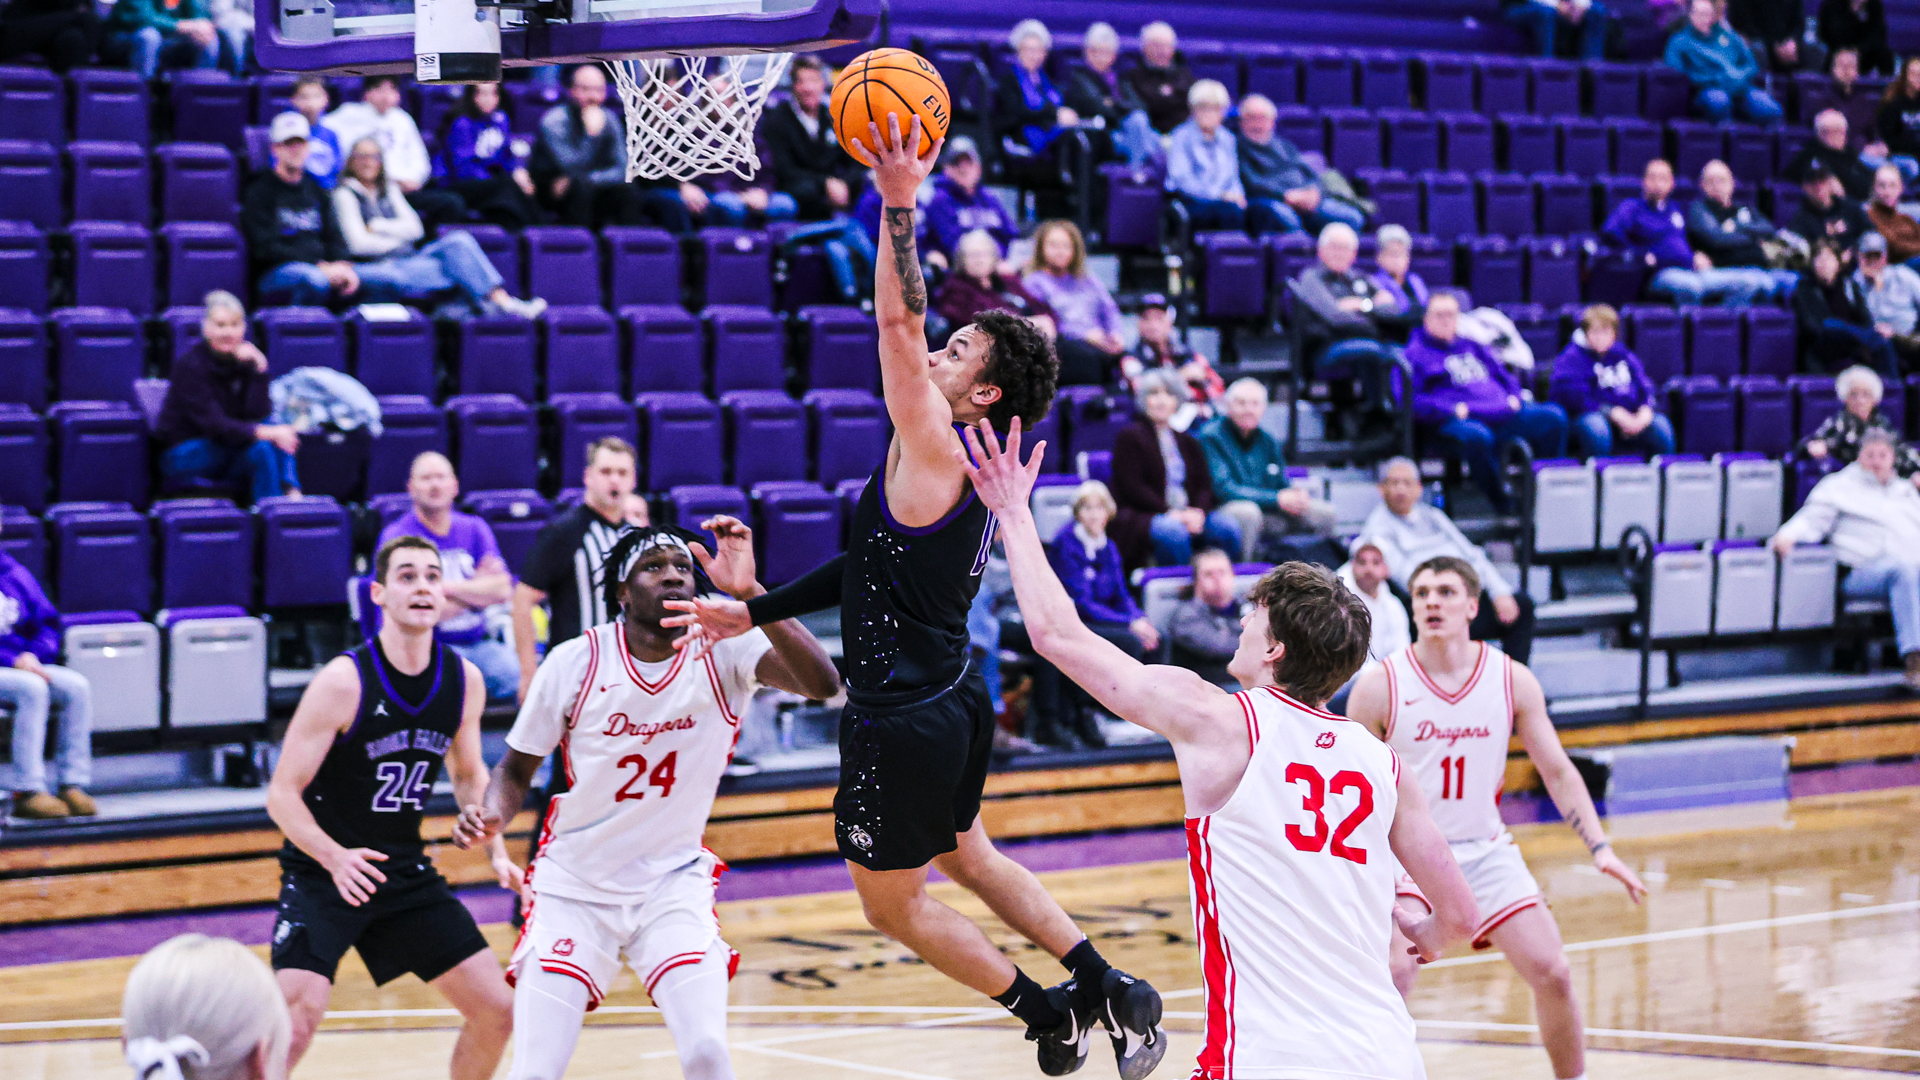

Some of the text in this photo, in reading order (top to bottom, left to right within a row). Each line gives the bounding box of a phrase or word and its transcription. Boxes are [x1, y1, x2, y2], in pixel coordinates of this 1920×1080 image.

[602, 712, 697, 745] Dragons
[1414, 719, 1490, 748] Dragons
[371, 761, 430, 813] 24
[615, 750, 678, 803] 24
[1440, 755, 1465, 800] 11
[1285, 762, 1374, 865] 32
